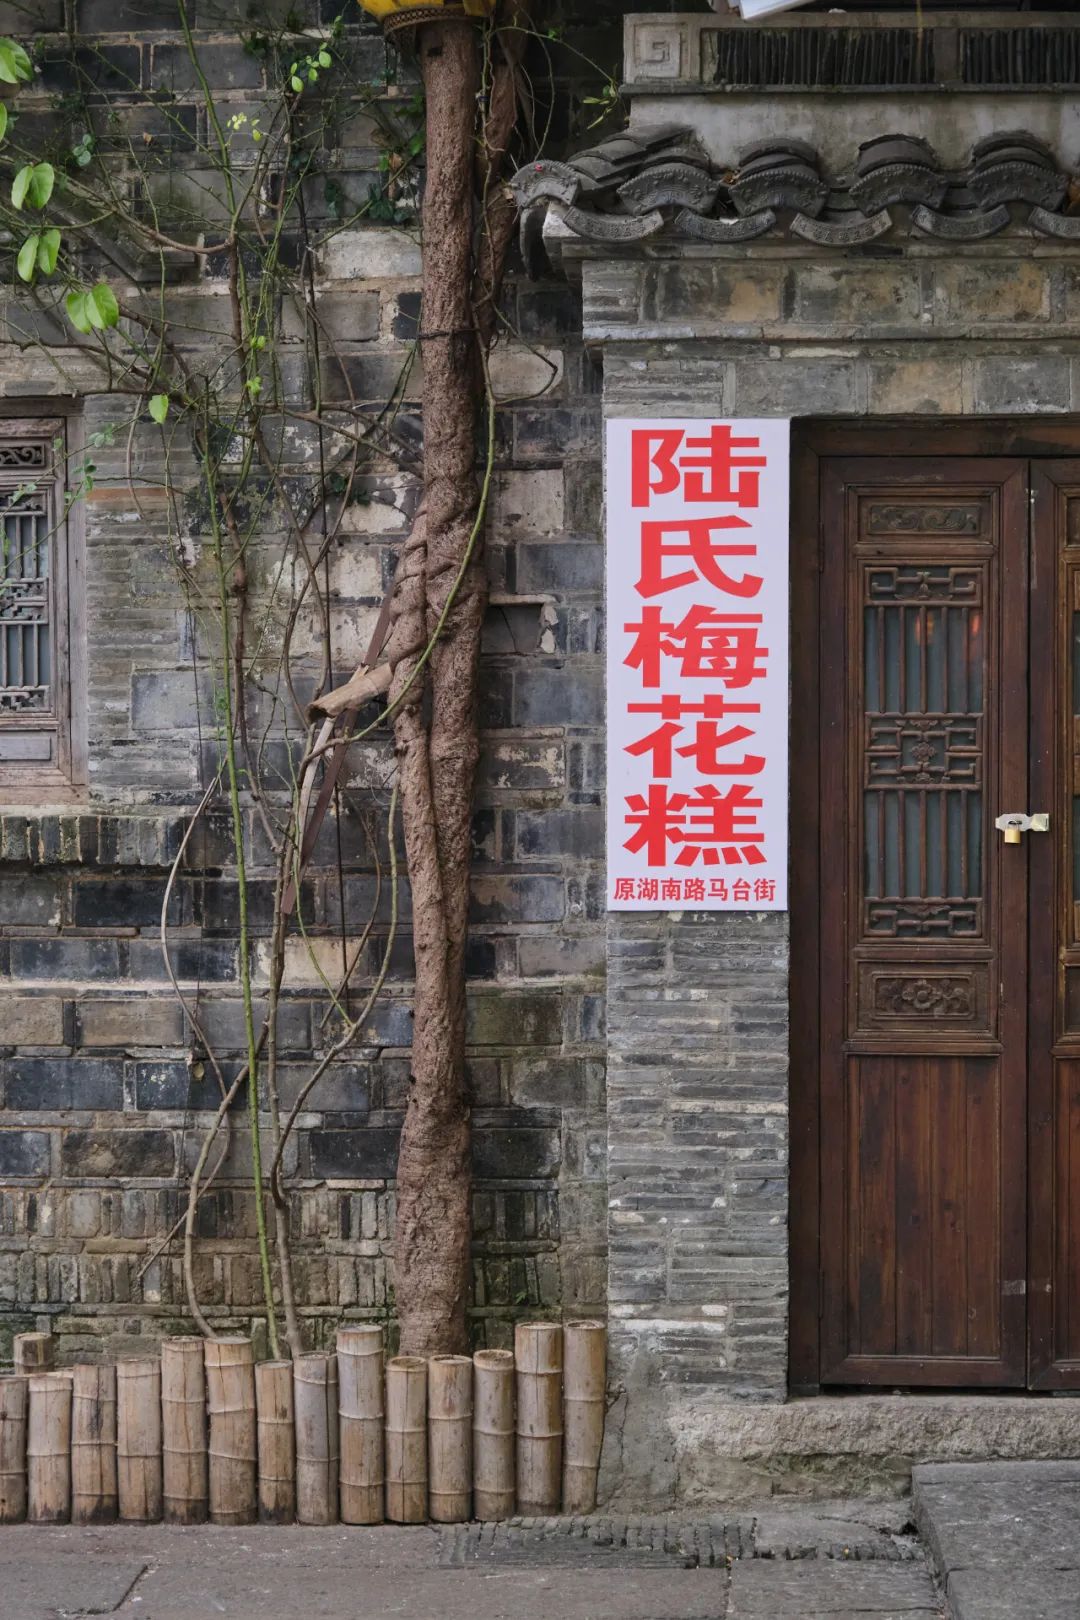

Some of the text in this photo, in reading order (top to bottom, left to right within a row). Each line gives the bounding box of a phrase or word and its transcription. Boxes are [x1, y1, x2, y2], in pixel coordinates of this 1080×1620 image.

[623, 425, 769, 867] 陆氏梅花糕
[614, 877, 776, 902] 原湖南路马台街
